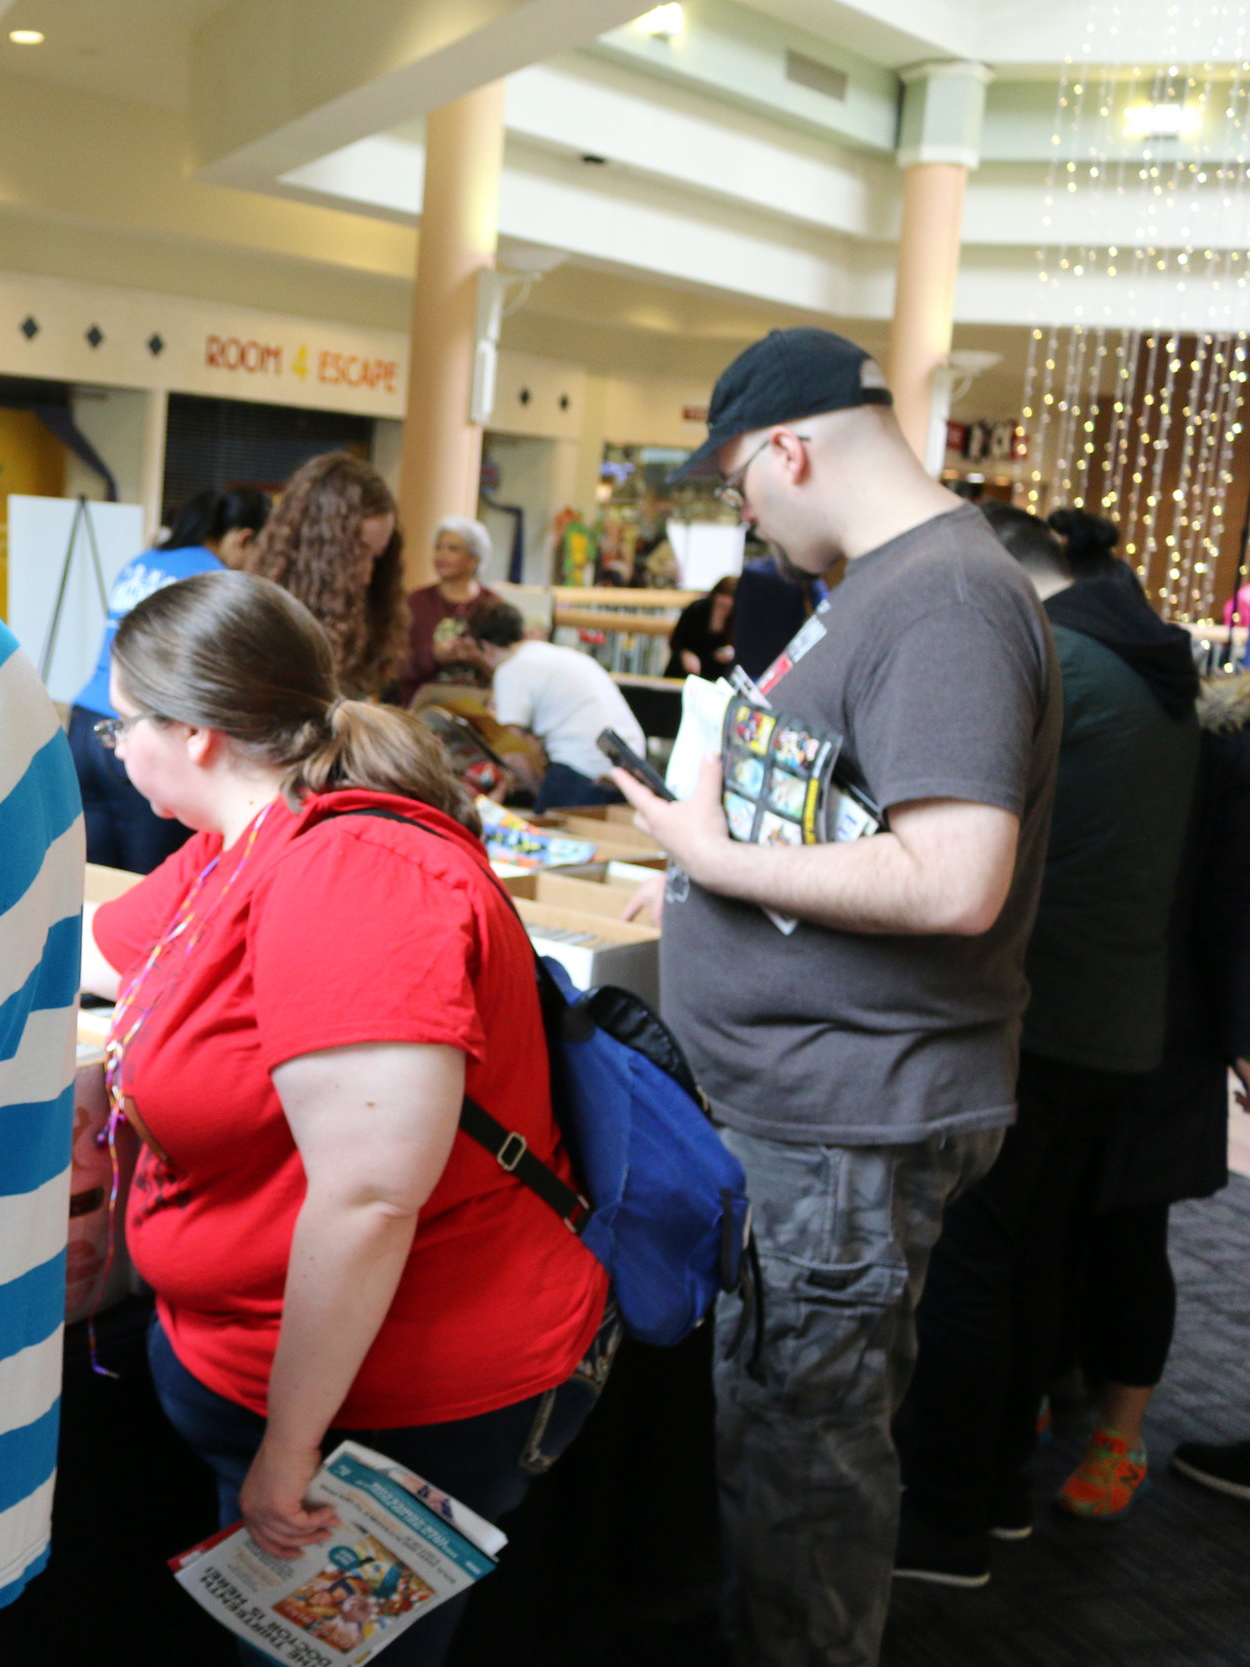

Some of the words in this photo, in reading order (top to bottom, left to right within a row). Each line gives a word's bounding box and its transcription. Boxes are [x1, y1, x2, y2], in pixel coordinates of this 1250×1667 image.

[205, 333, 283, 377] ROOM
[291, 343, 308, 381] 4
[317, 350, 399, 393] ESCAPE
[204, 1565, 249, 1606] HERE!
[200, 1575, 285, 1650] THIRTEENTH
[268, 1621, 332, 1667] DOCTOR
